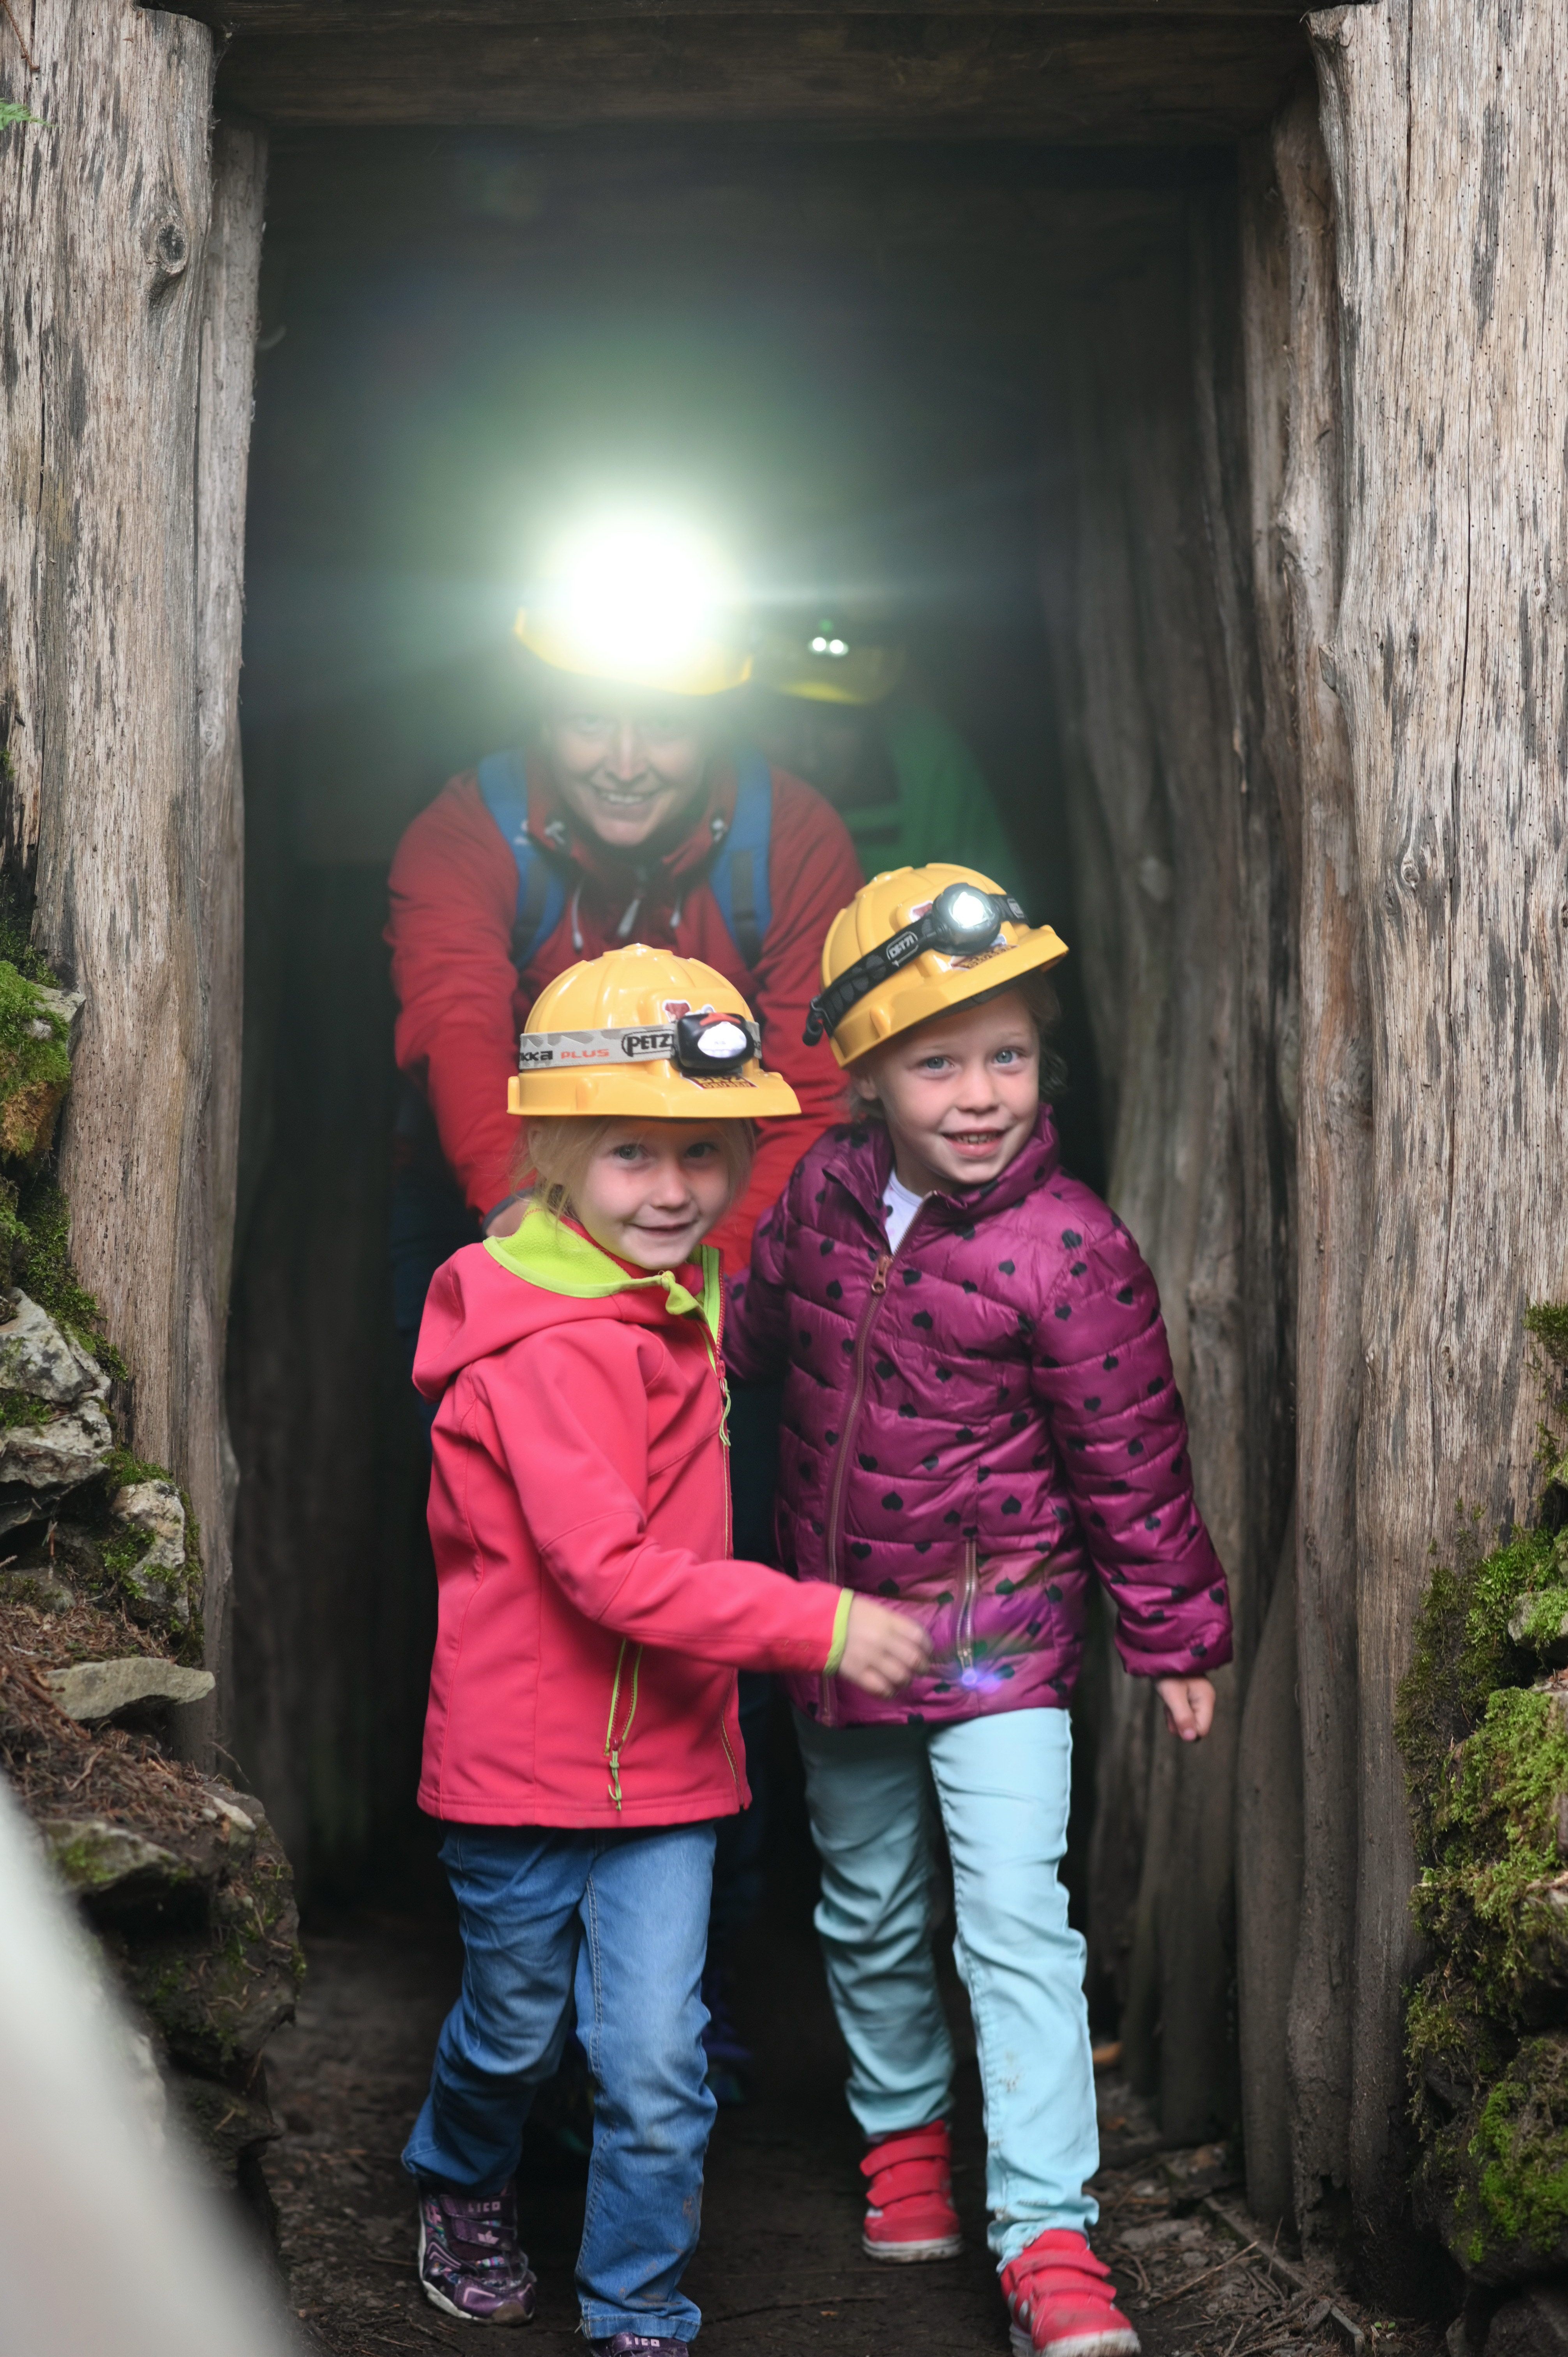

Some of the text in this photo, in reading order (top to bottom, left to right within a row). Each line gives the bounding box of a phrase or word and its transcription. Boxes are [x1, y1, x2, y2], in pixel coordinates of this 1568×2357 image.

[560, 1049, 609, 1059] PLUS
[468, 2202, 501, 2212] LICO
[625, 2337, 660, 2347] LICO
